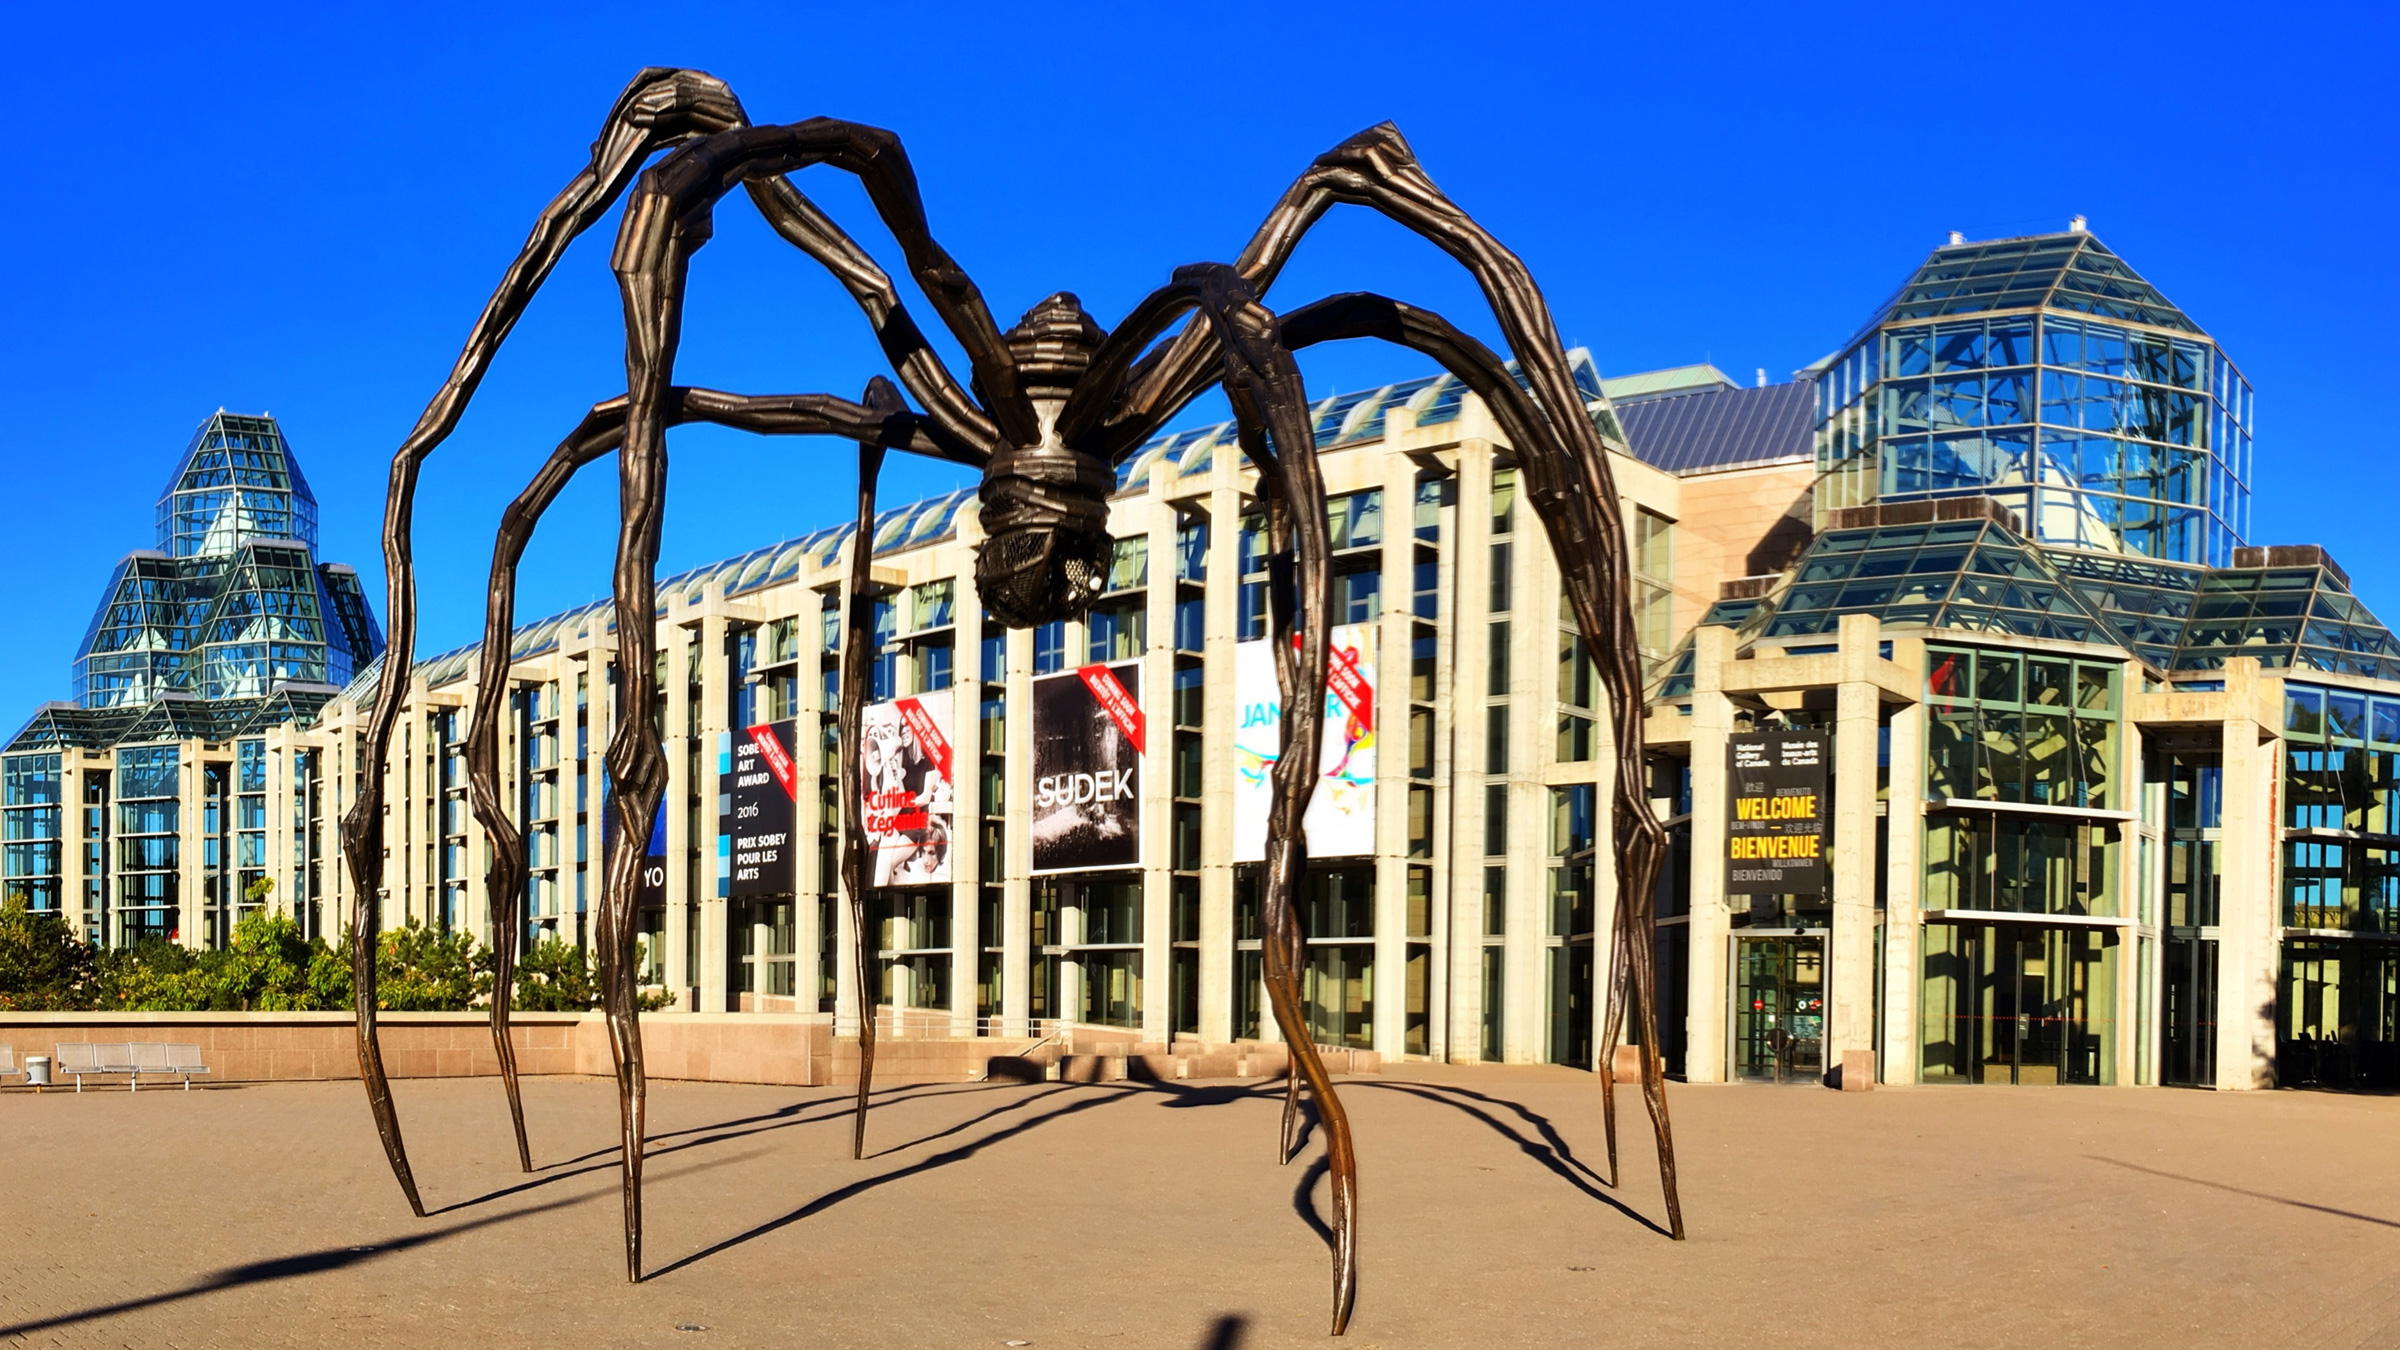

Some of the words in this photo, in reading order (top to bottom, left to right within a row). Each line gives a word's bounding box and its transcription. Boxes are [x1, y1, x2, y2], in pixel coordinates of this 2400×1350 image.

[1102, 673, 1123, 700] COMING
[1120, 696, 1136, 717] SOON
[737, 742, 763, 757] SOBE
[737, 759, 755, 772] ART
[1744, 759, 1771, 767] Canada
[1792, 757, 1819, 766] Canada
[737, 772, 770, 788] AWARD
[1037, 768, 1134, 807] SUDEK
[868, 787, 917, 811] Cutline
[1776, 787, 1812, 796] BENVENUTO
[737, 802, 759, 818] 2016
[1736, 796, 1817, 820] WELCOME
[737, 835, 757, 850] PRIX
[758, 833, 787, 847] SOBEY
[1731, 835, 1820, 859] BIENVENUE
[737, 852, 761, 866] POUR
[762, 850, 777, 863] LES
[1772, 859, 1813, 867] WILLKOMMEN
[644, 866, 664, 888] YO
[737, 869, 759, 881] ARTS
[1732, 869, 1782, 881] BIENVENIDO
